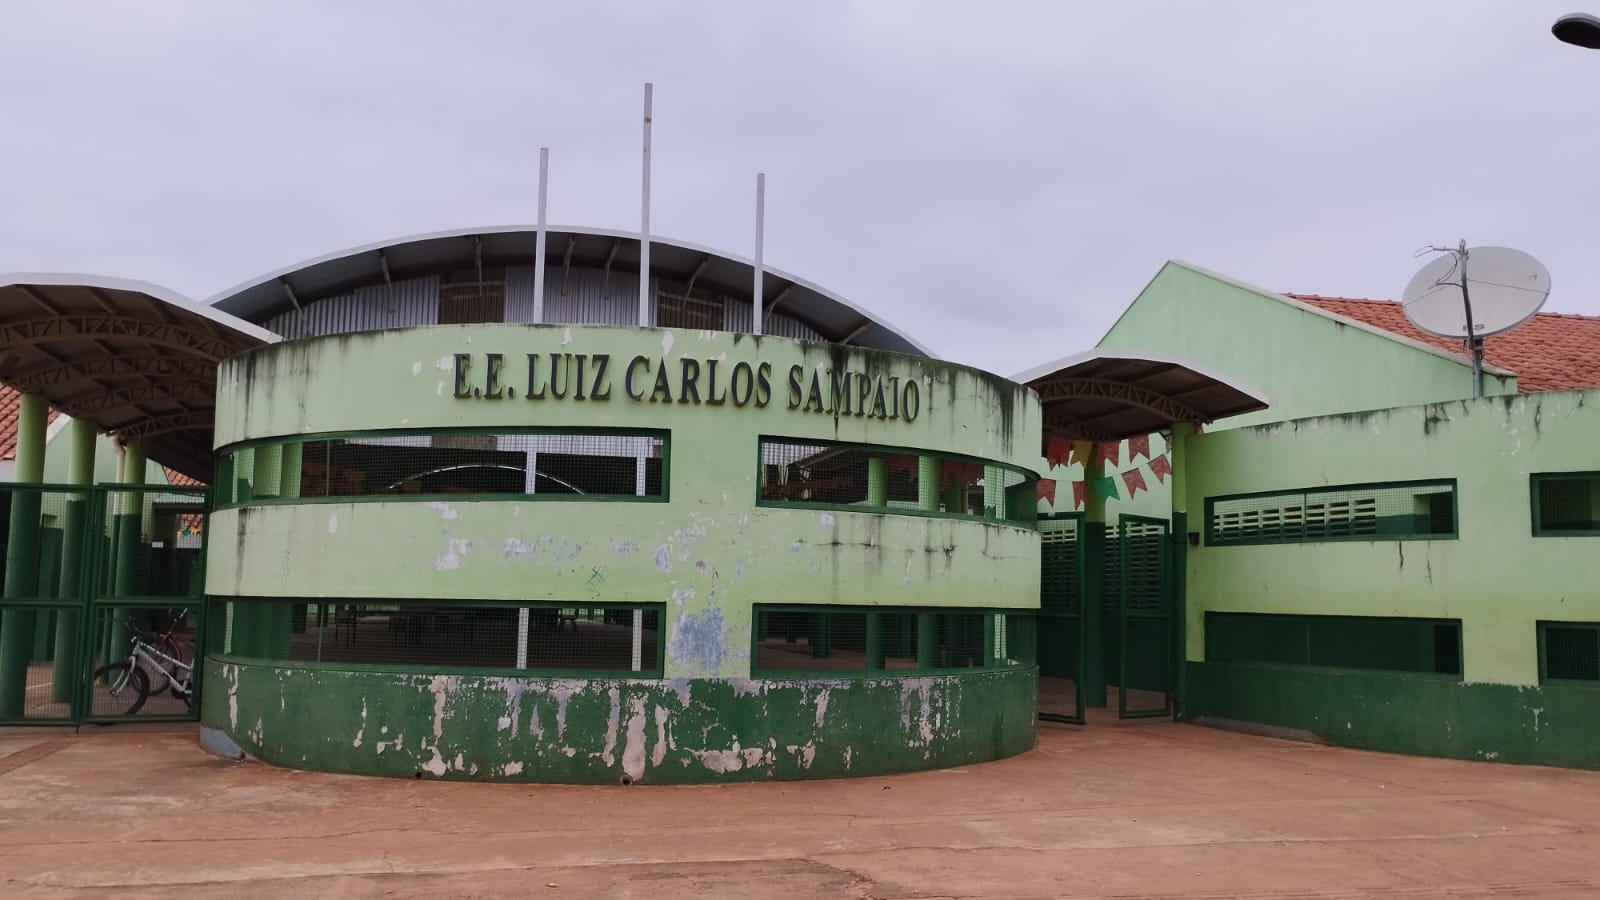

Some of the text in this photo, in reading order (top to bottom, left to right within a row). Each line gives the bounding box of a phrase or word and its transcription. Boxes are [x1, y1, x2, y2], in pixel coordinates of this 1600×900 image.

[453, 354, 920, 423] E.E. LUIZ CARLOS SAMPAIO
